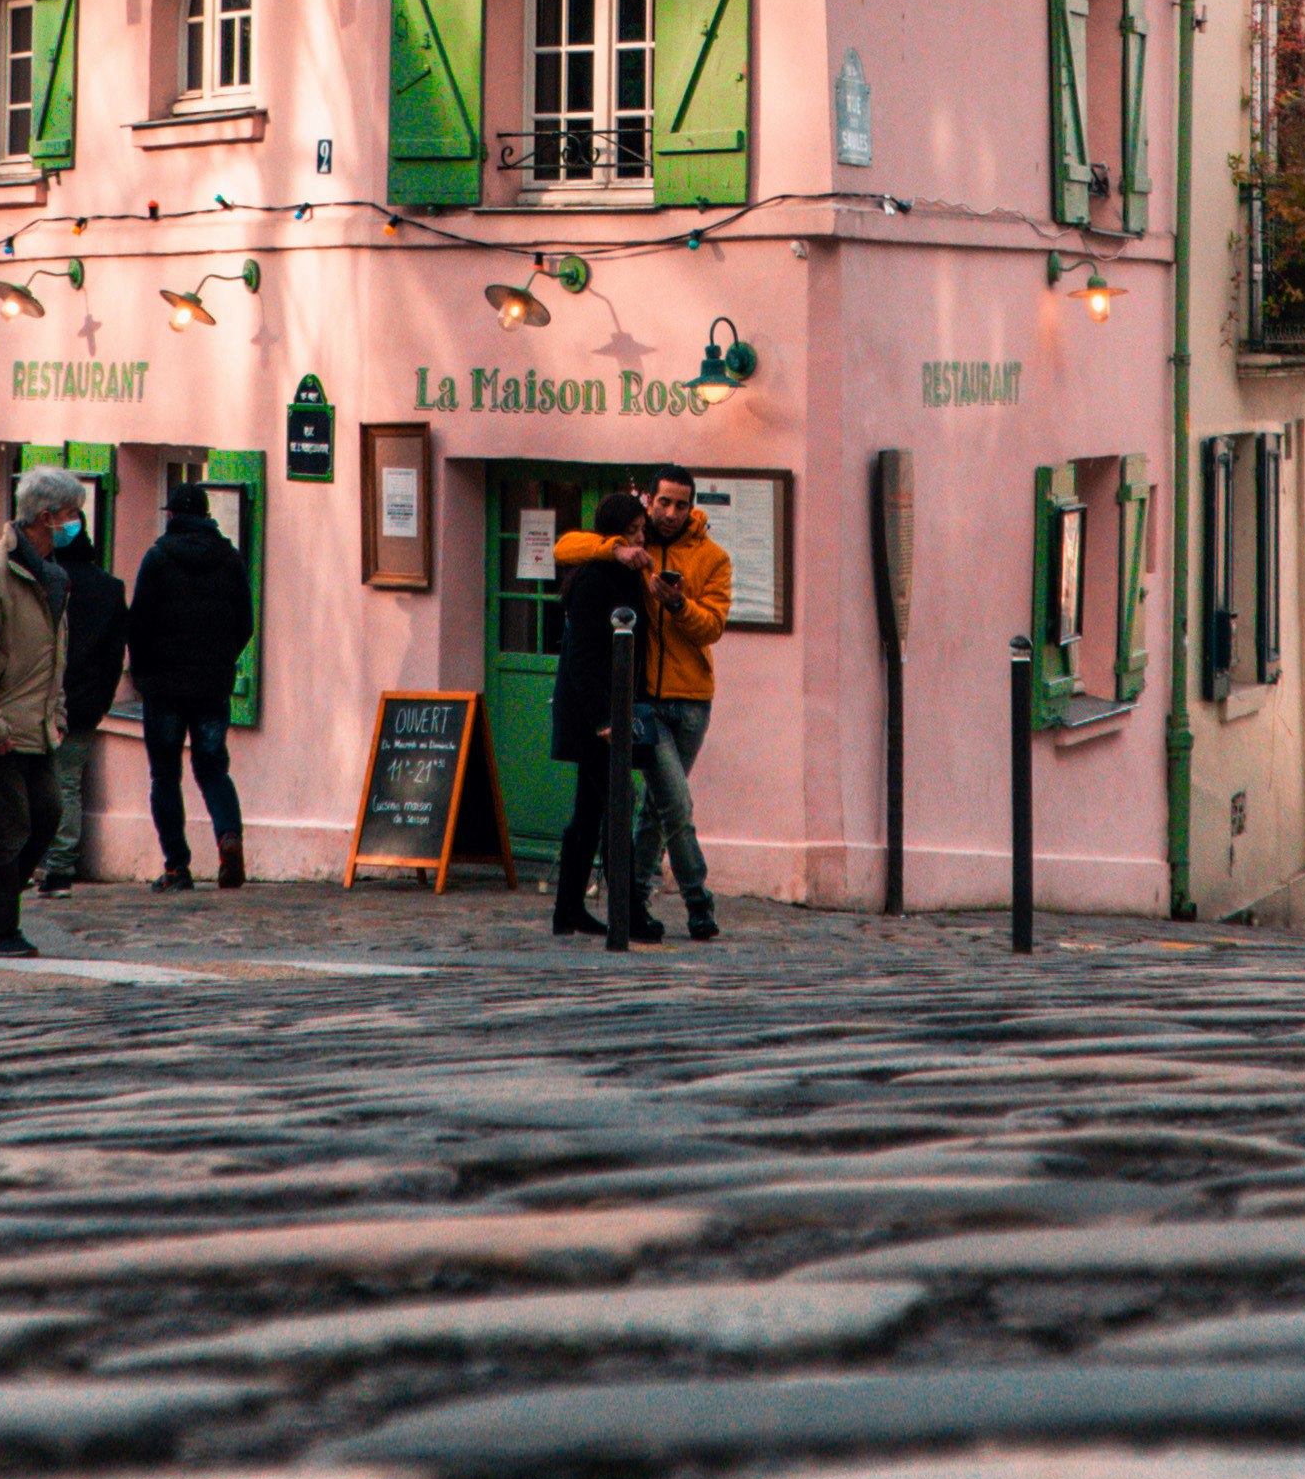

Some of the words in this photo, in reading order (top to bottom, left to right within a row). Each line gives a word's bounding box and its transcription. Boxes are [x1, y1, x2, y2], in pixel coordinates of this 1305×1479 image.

[319, 141, 330, 173] 2
[12, 360, 149, 403] RESTAURANT
[413, 366, 460, 413] La
[469, 367, 608, 414] Maison
[922, 361, 1022, 408] RESTAURANT
[395, 707, 452, 734] OUVERT
